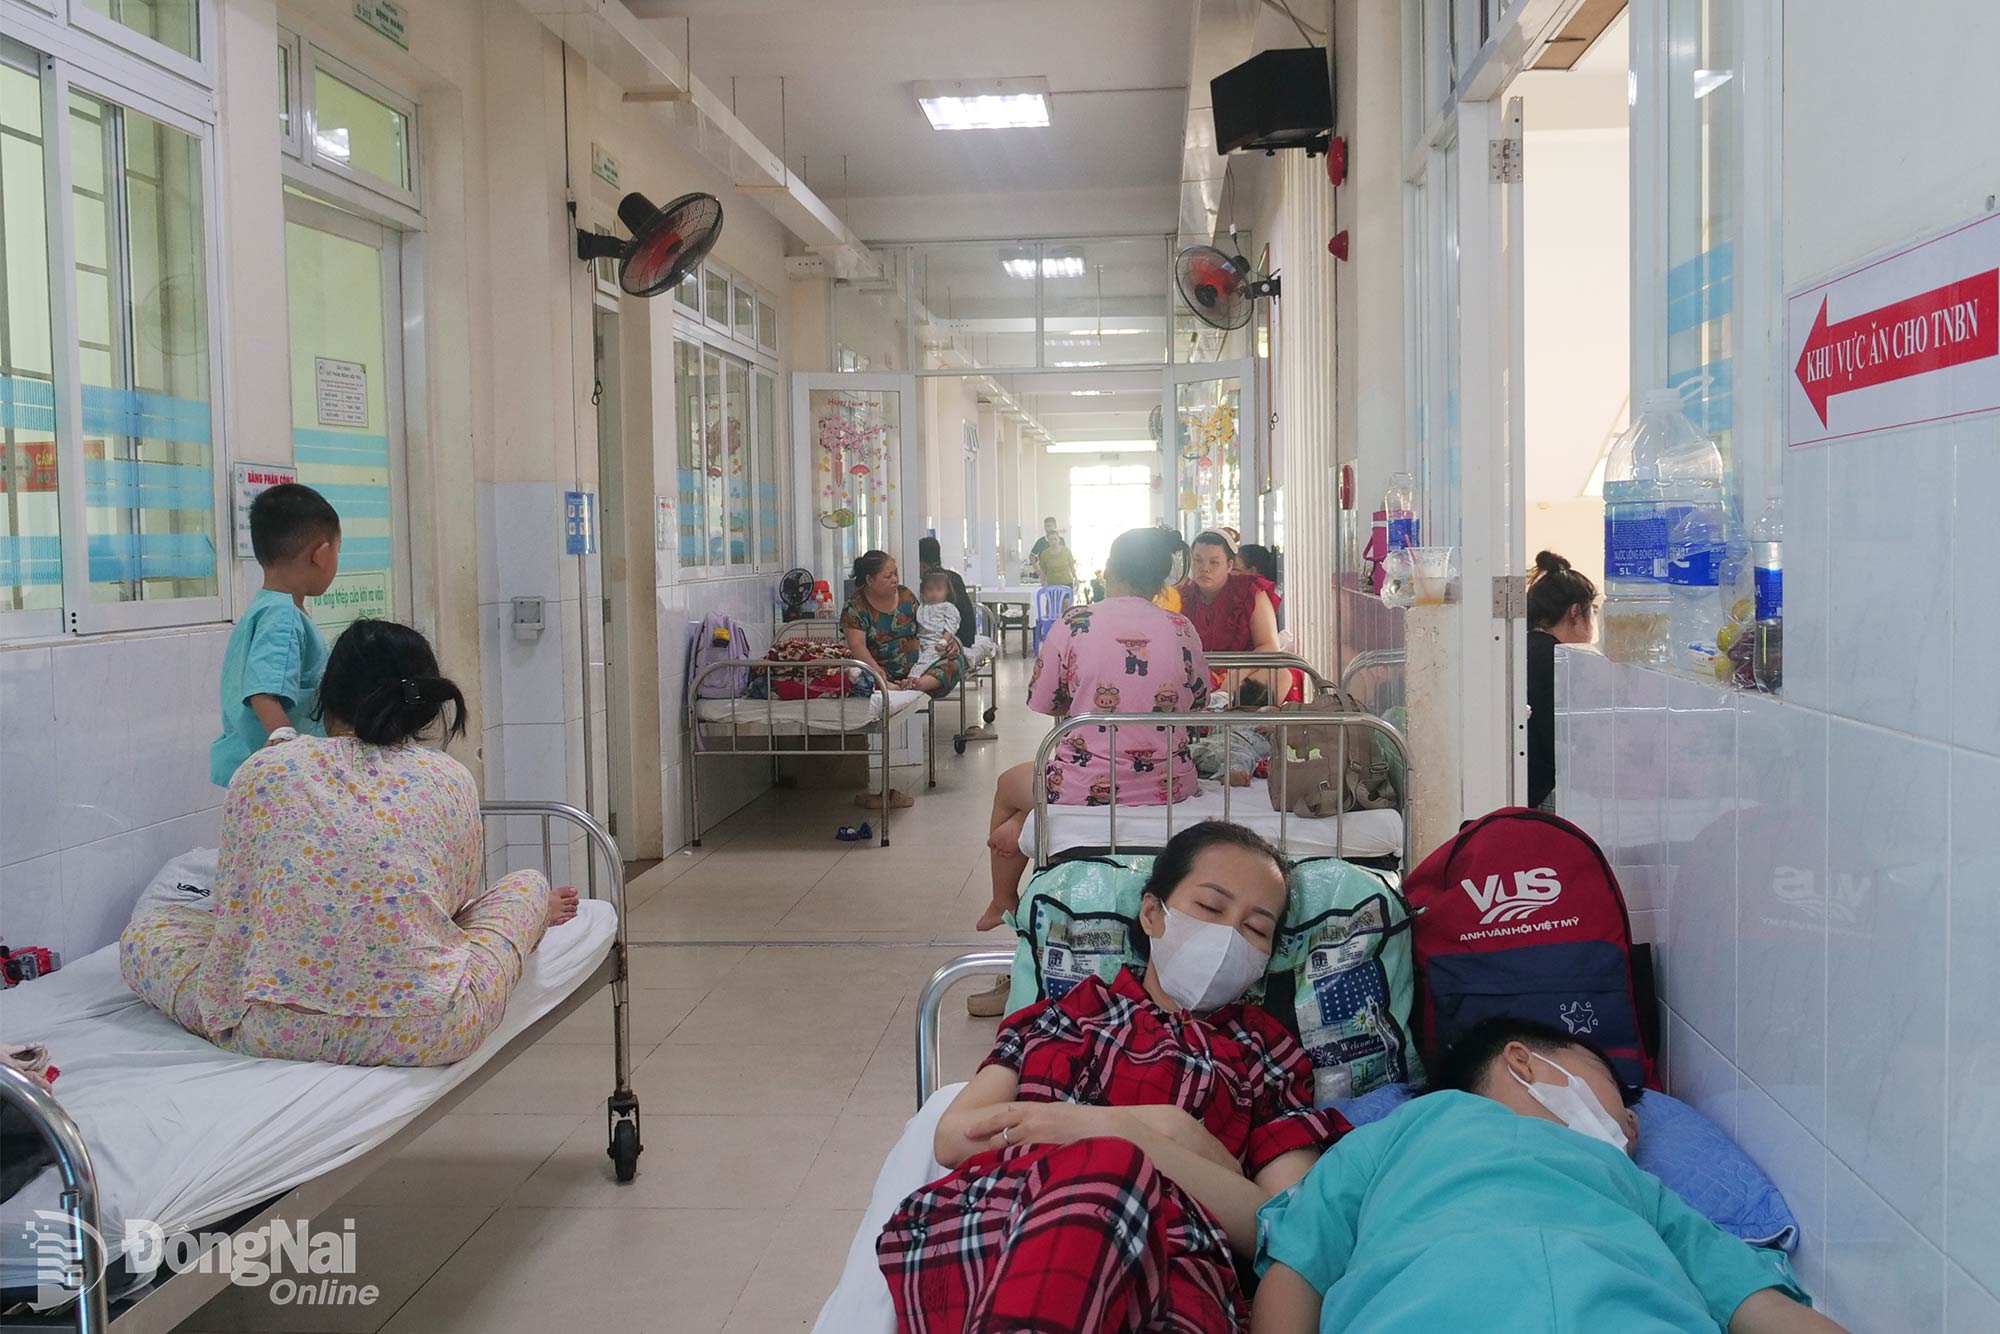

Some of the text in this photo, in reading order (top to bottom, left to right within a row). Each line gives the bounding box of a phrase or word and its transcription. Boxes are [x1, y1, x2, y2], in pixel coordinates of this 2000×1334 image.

[1806, 299, 1979, 383] KHU VỰC ĂN CHO TNBN
[1460, 867, 1562, 913] VUS
[1460, 931, 1486, 942] ANH
[1512, 923, 1532, 935] HỘI
[1533, 919, 1560, 931] VIỆT
[1560, 916, 1580, 928] MỸ
